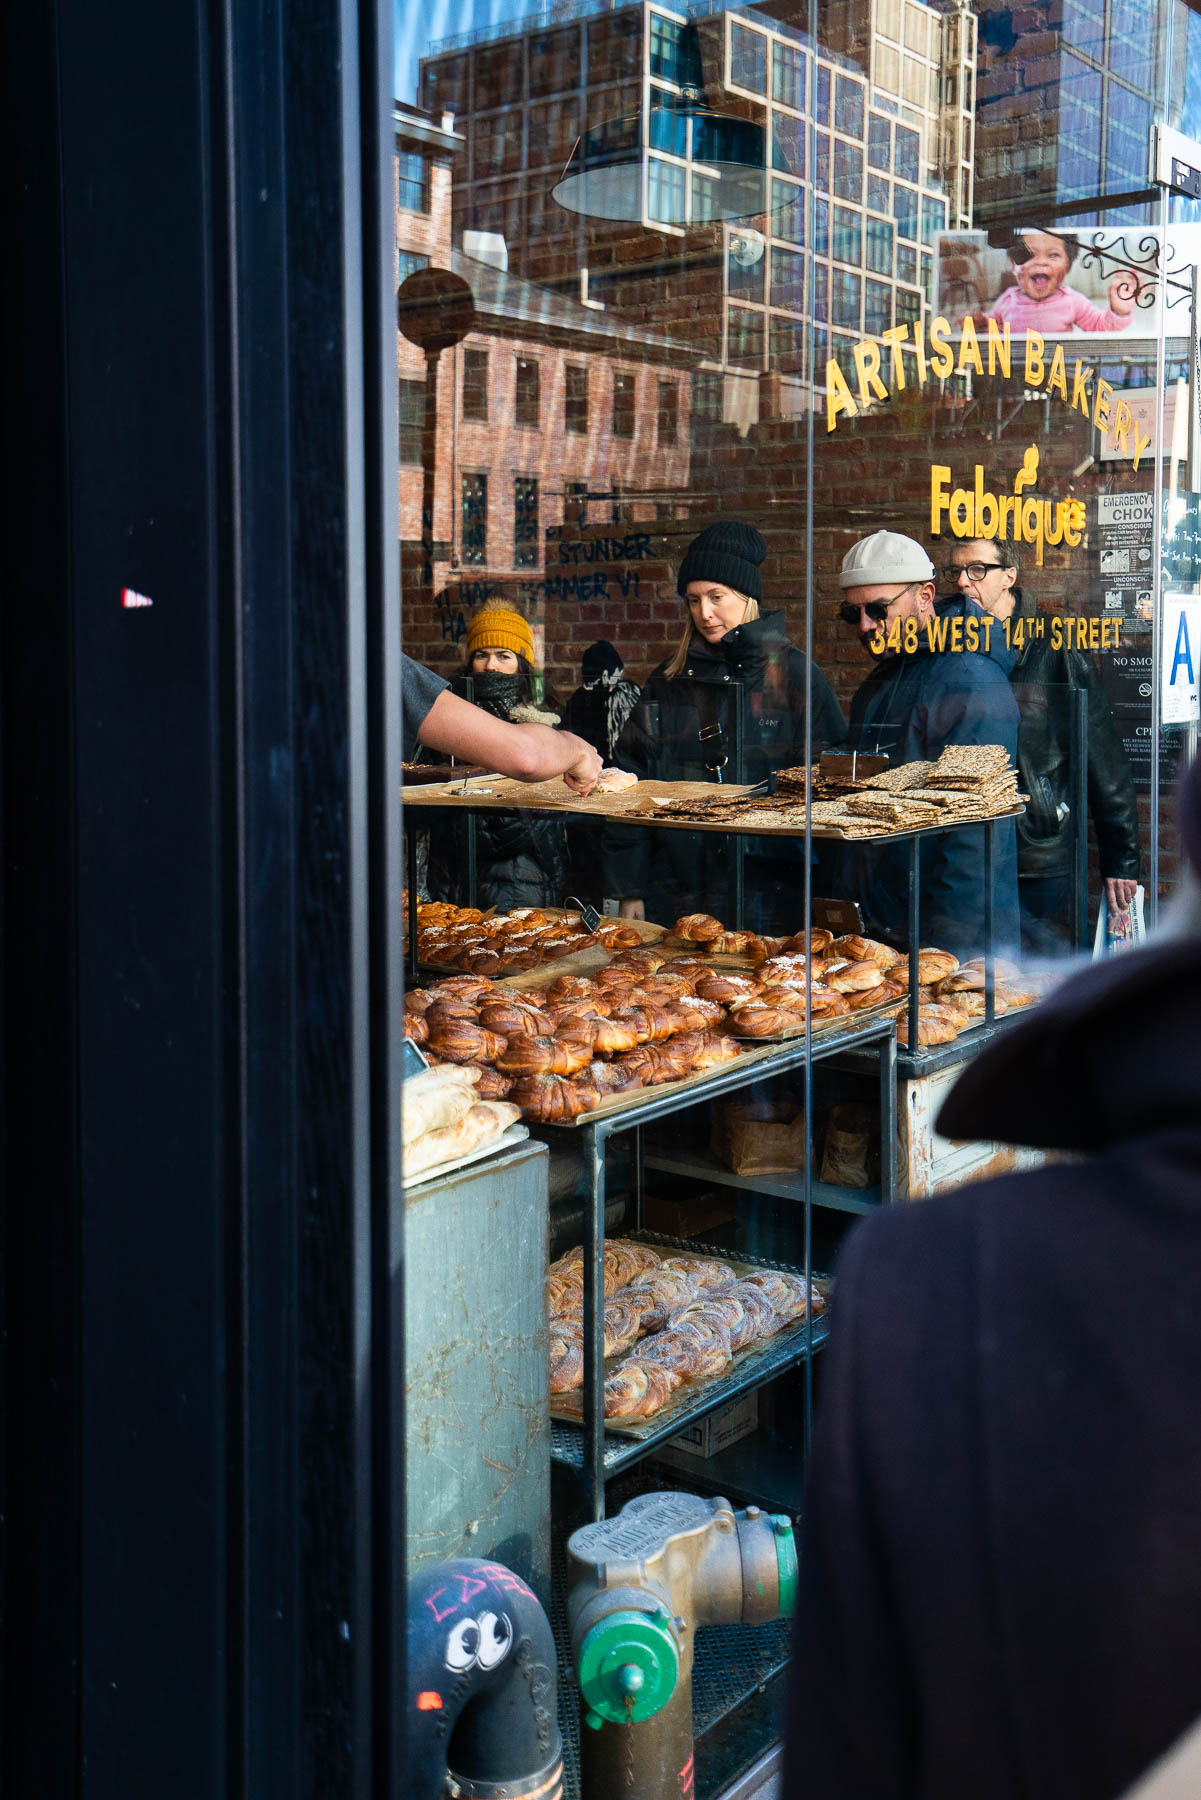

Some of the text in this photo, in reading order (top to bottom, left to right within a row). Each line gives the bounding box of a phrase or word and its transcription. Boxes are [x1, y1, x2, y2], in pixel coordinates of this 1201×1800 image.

[826, 316, 1150, 472] ARTISAN BAKERY
[930, 443, 1087, 566] Fabrique
[1103, 494, 1149, 507] EMERGENCY
[1117, 522, 1152, 530] CONSCIOUS
[559, 533, 657, 565] STUNDER
[615, 570, 640, 599] VI
[870, 616, 919, 655] 348
[927, 615, 995, 653] WEST
[1002, 616, 1045, 650] 14TH
[1051, 616, 1123, 651] STREET
[1169, 610, 1195, 686] A
[1113, 657, 1153, 666] NO SMO
